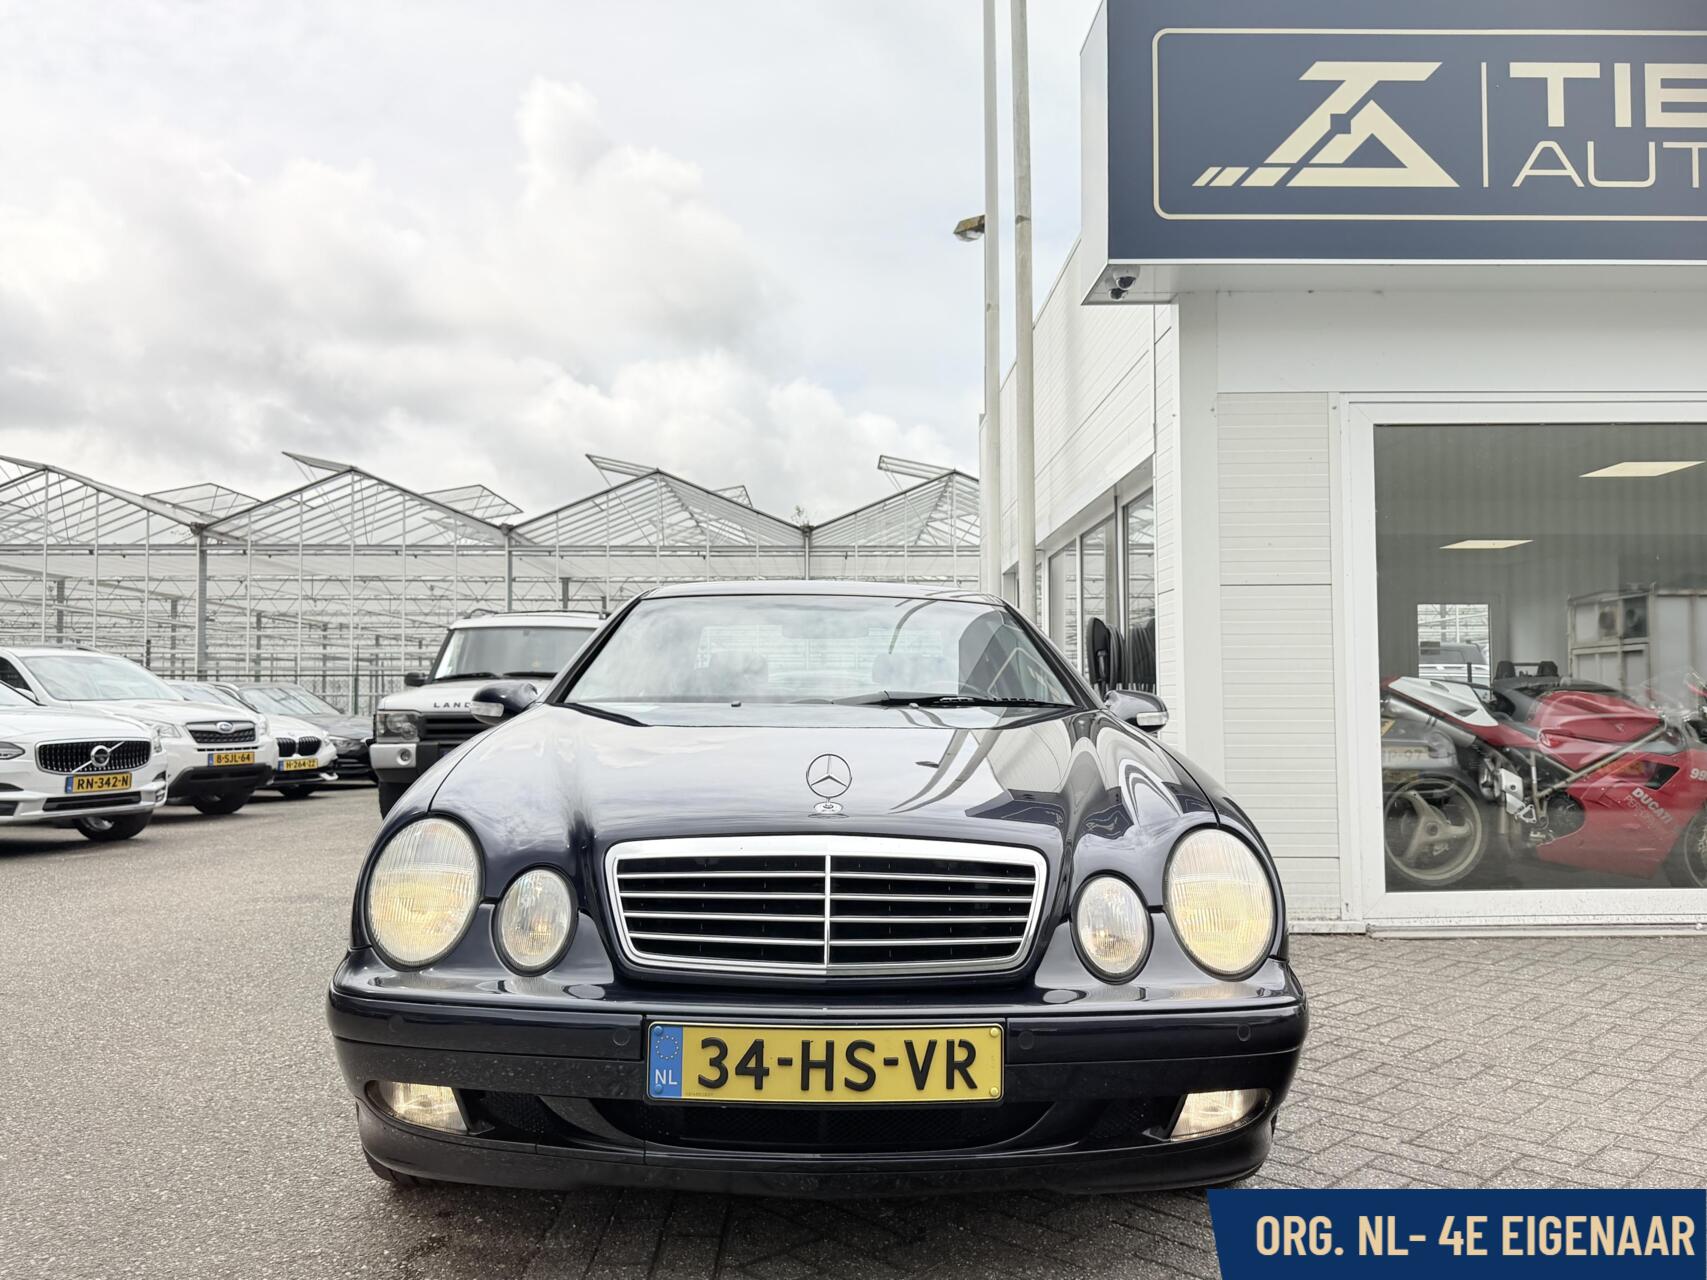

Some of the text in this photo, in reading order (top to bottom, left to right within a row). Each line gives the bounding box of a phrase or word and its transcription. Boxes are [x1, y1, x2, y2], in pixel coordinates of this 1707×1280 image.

[1510, 62, 1707, 128] TIE
[1512, 140, 1707, 188] AUT
[77, 775, 129, 791] RN-342-N
[1632, 787, 1673, 824] DUCATI
[655, 1037, 978, 1092] NL 34-HS-VR
